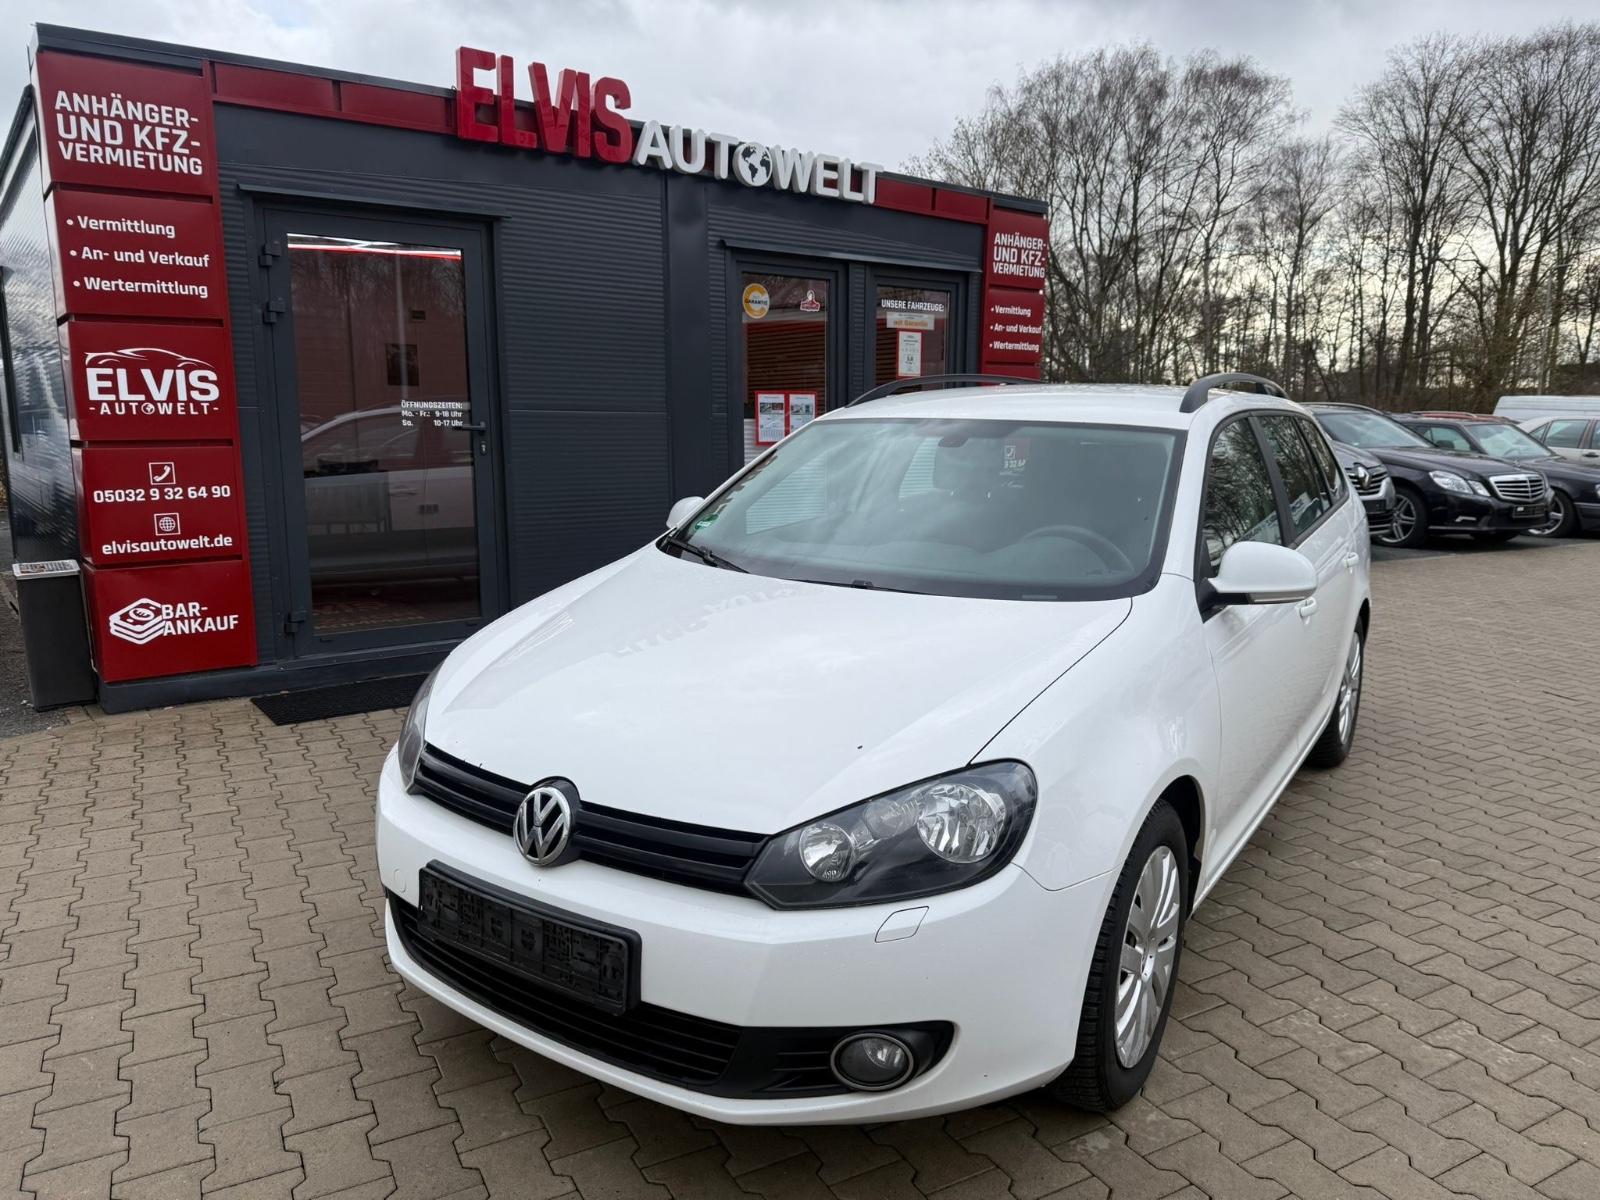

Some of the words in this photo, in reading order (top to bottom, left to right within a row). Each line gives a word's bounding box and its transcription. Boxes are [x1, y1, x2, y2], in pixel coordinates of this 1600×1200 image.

[55, 90, 199, 129] ANHÄNGER-
[56, 113, 123, 145] UND
[134, 124, 201, 155] KFZ-
[456, 46, 632, 164] ELVIS
[632, 119, 884, 205] AUTOWELT
[58, 141, 203, 176] VERMIETUNG
[77, 215, 176, 239] Vermittlung
[994, 232, 1047, 251] ANHÄNGER-
[81, 246, 110, 261] An-
[114, 249, 145, 264] und
[149, 251, 210, 268] Verkauf
[993, 246, 1018, 263] UND
[1020, 250, 1046, 267] KFZ-
[993, 262, 1046, 279] VERMIETUNG
[84, 276, 209, 299] Wertermittlung
[881, 299, 907, 310] UNSERE
[907, 301, 945, 312] FAHRZEUGE:
[995, 304, 1032, 318] Vermittlung
[994, 323, 1006, 332] An-
[1006, 324, 1018, 333] und
[1019, 325, 1043, 335] Verkauf
[993, 341, 1041, 353] Wertermittlung
[86, 367, 220, 403] ELVIS
[401, 399, 463, 409] ÖFFNUNGSZEITEN:
[450, 410, 463, 418] Uhr
[402, 419, 414, 427] Sa.
[433, 419, 450, 427] 10-17
[451, 419, 464, 427] Uhr
[93, 488, 146, 504] 05032
[150, 487, 159, 501] 9
[163, 487, 183, 501] 32
[187, 486, 208, 500] 64
[210, 484, 231, 499] 90
[101, 534, 233, 555] elvisautowelt.de
[161, 601, 208, 619] BAR-
[163, 614, 239, 637] ANKAUF
